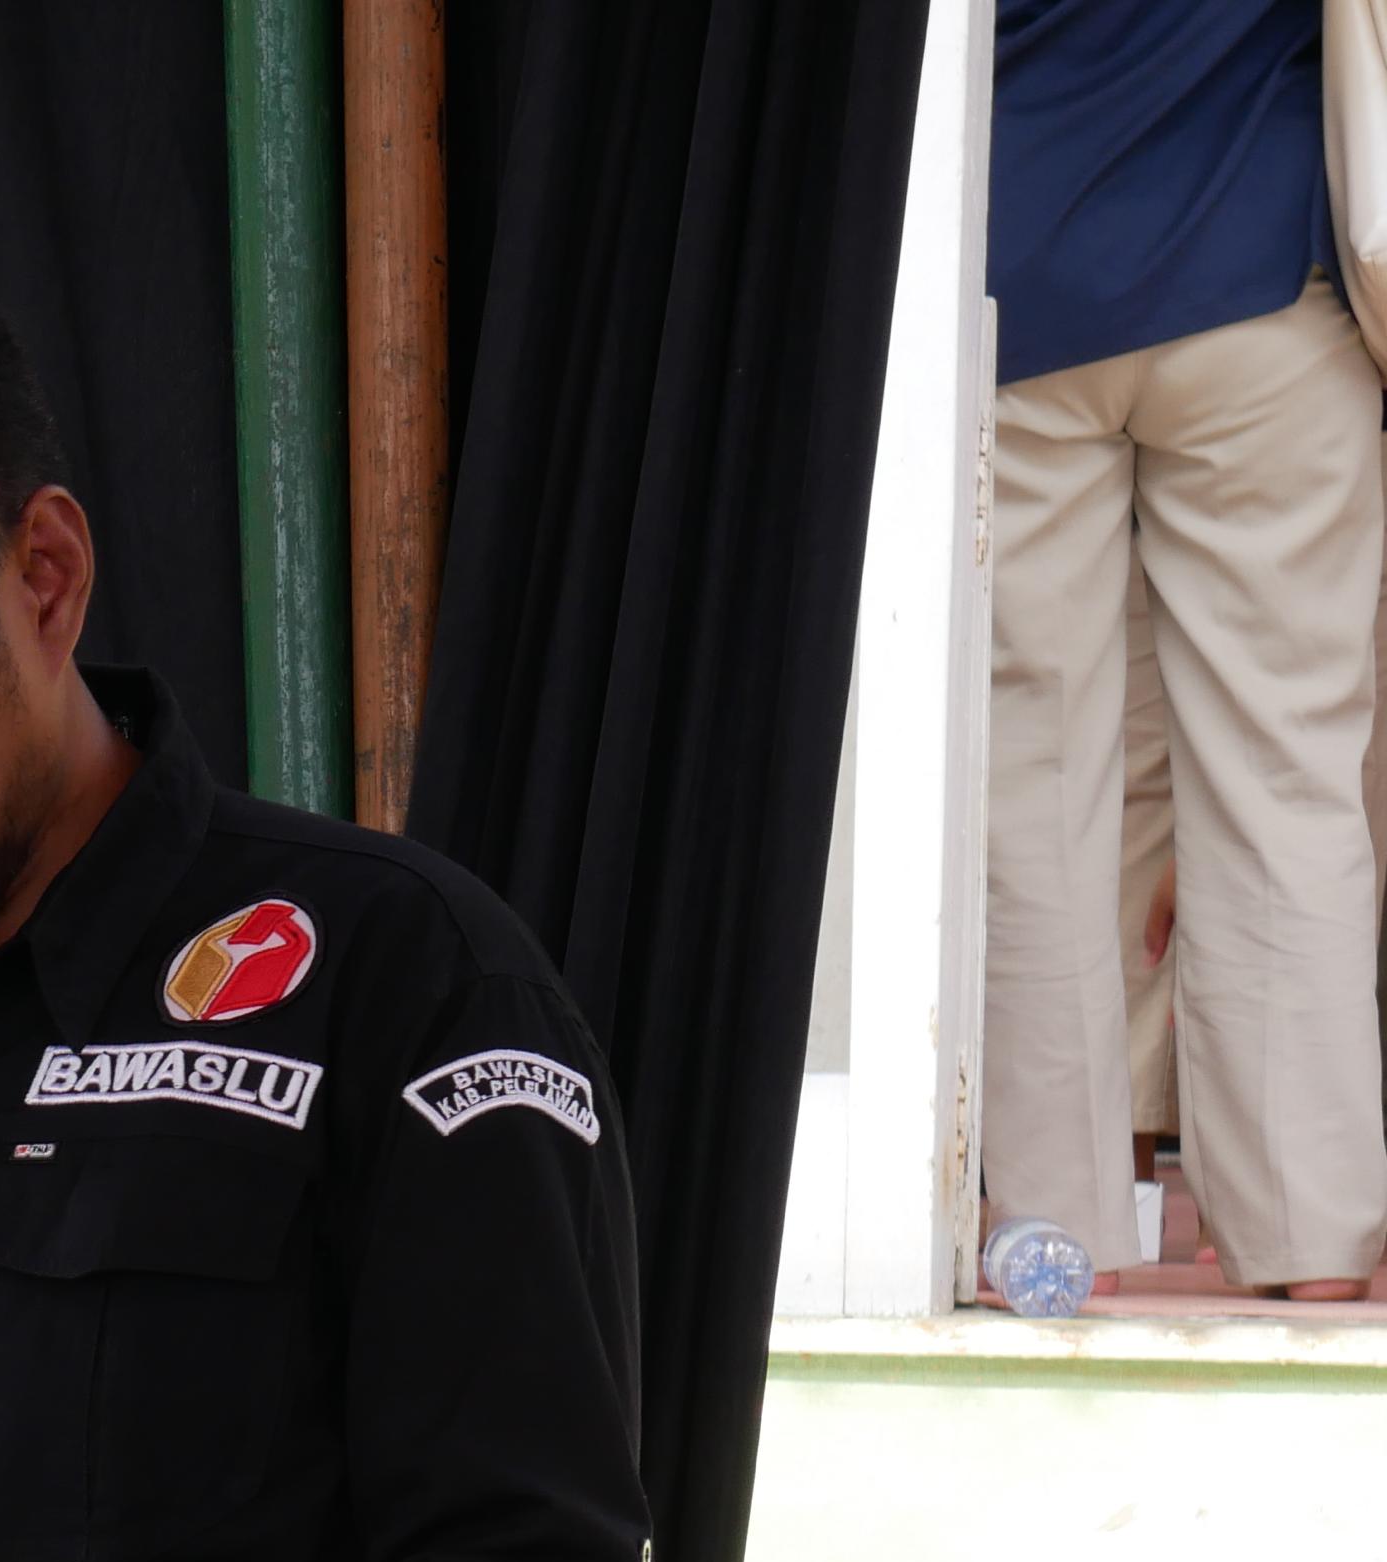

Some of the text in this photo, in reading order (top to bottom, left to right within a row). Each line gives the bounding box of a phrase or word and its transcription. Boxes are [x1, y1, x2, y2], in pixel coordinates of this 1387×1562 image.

[41, 1049, 306, 1112] BAWASLU
[452, 1060, 576, 1097] BAWASLU
[436, 1087, 487, 1119] KAB.
